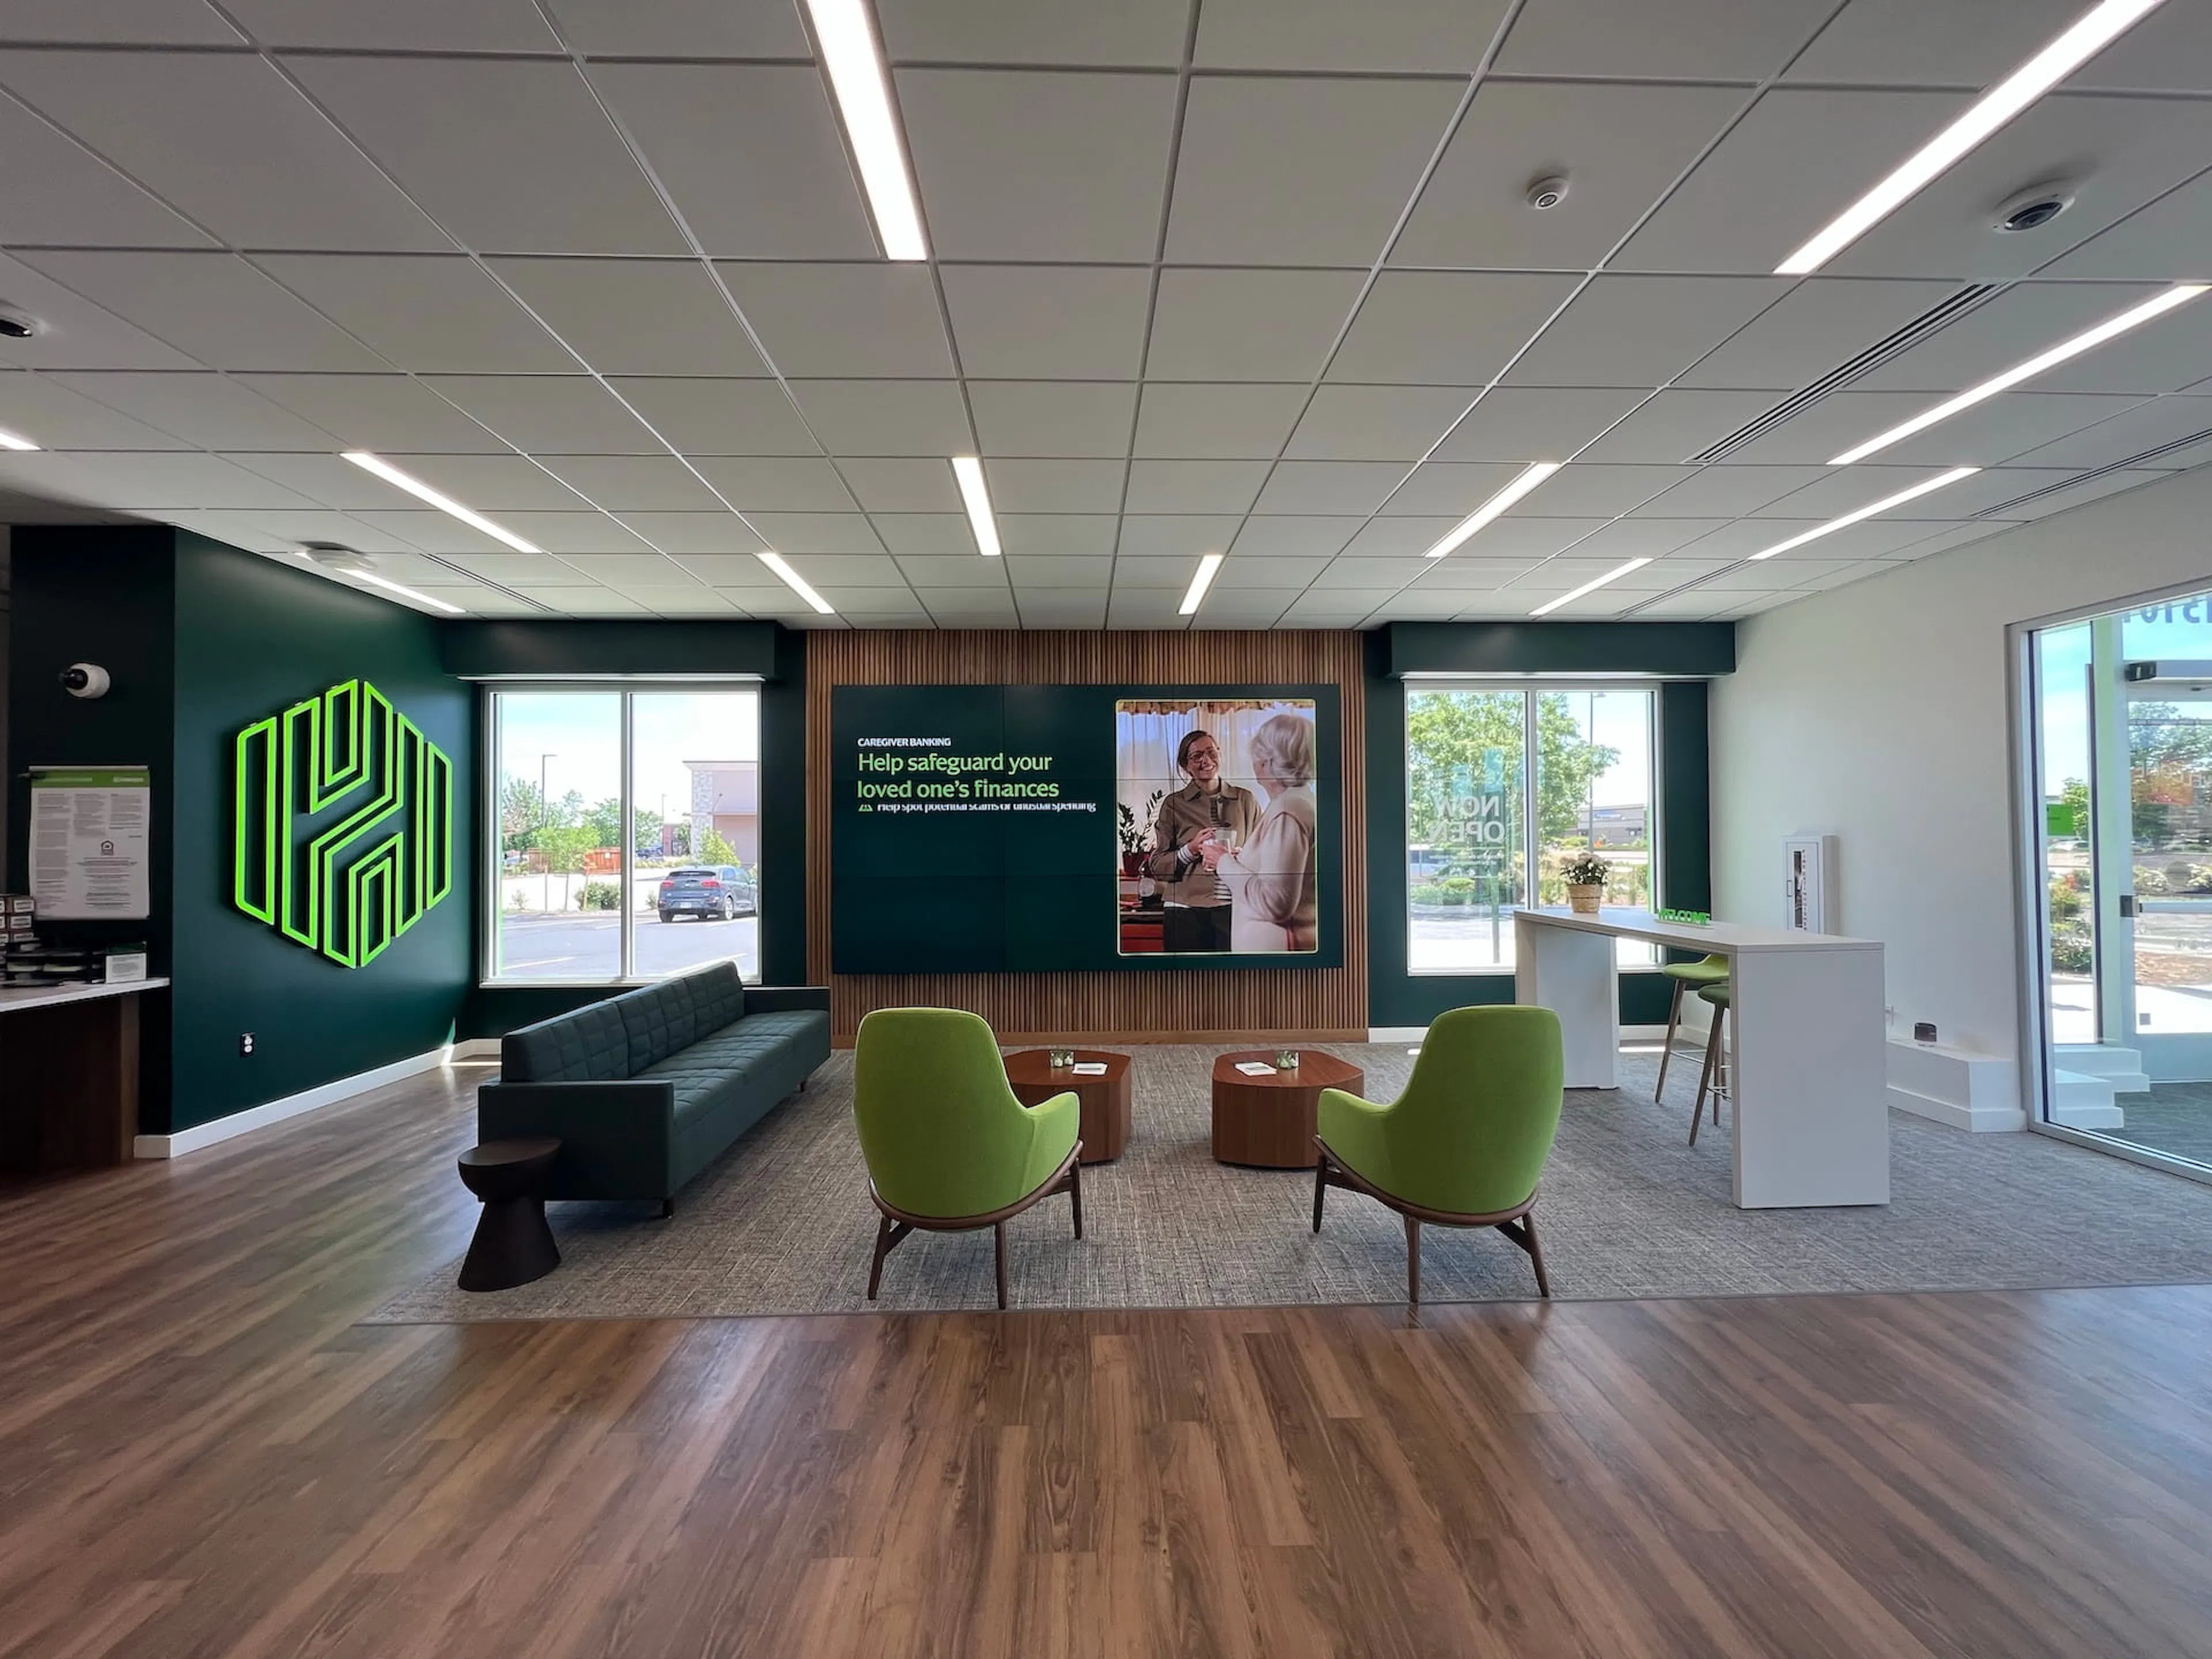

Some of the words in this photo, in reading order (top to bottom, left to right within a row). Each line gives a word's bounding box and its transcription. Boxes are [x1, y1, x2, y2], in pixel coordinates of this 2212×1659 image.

[857, 737, 908, 747] CAREGIVER
[909, 737, 952, 747] BANKING
[858, 752, 904, 776] Help
[907, 752, 1004, 776] safeguard
[1008, 756, 1053, 775] your
[857, 779, 912, 798] loved
[916, 780, 970, 798] one’s
[974, 778, 1060, 798] finances
